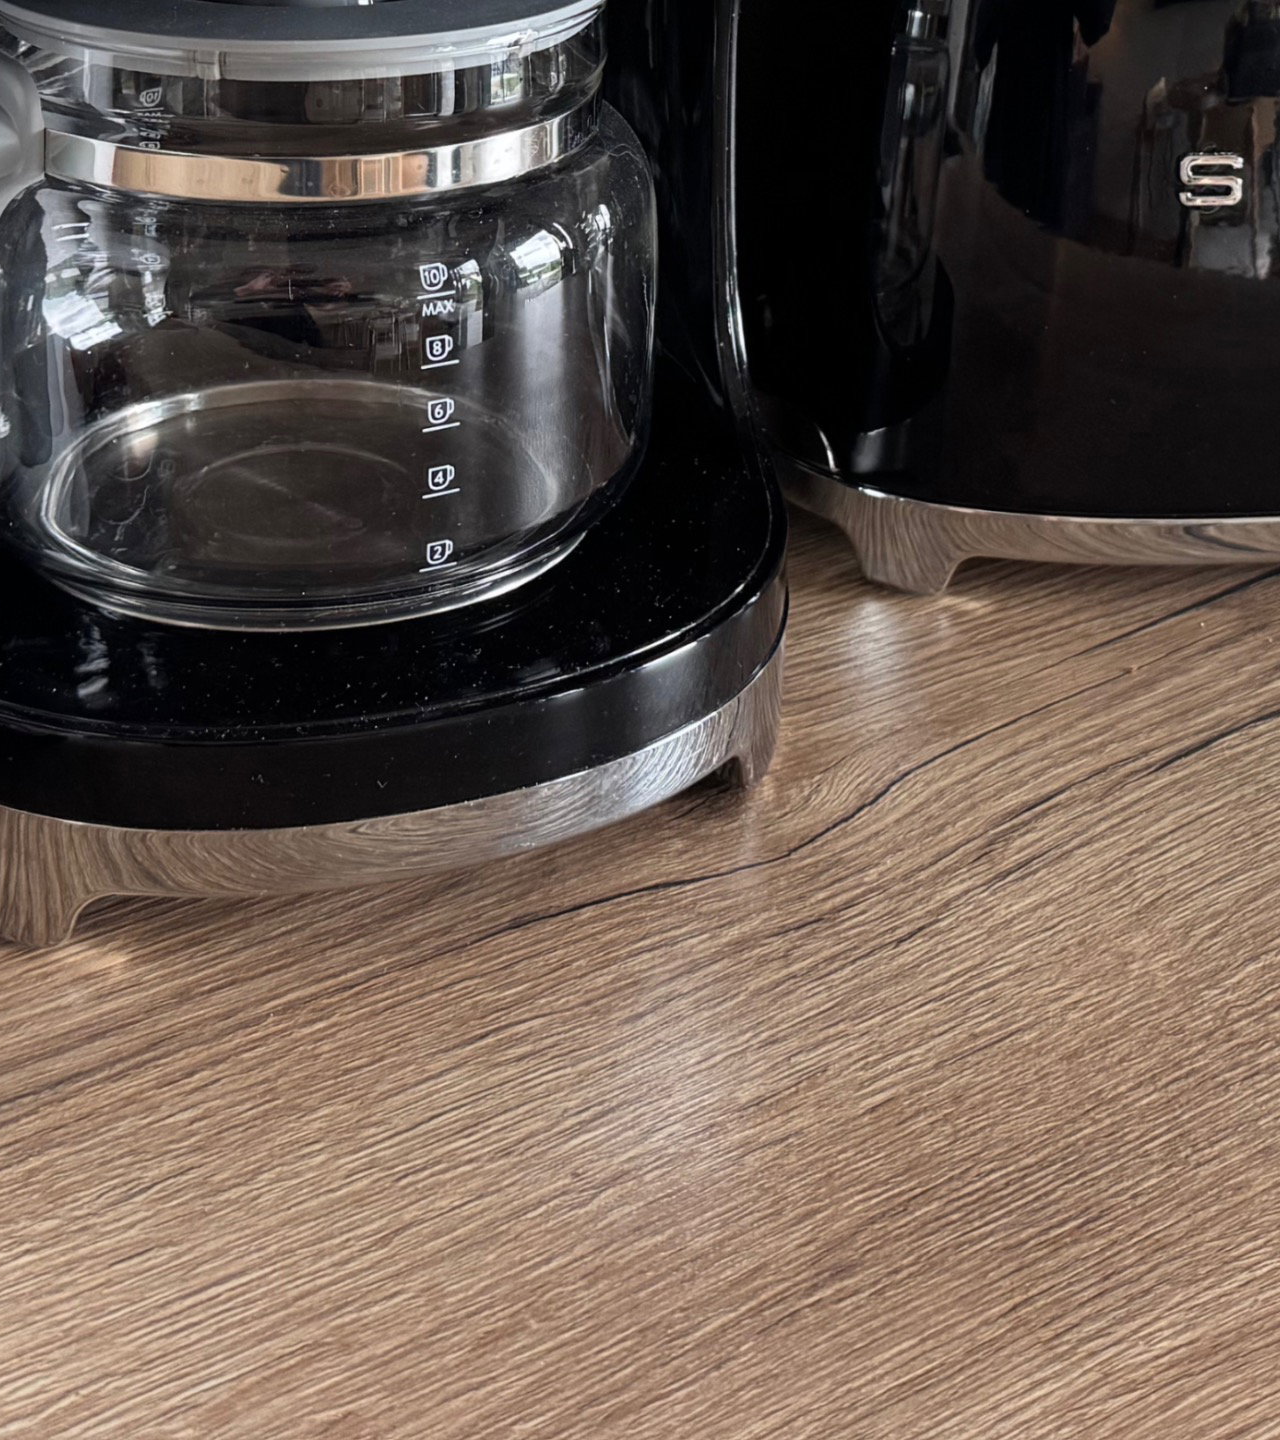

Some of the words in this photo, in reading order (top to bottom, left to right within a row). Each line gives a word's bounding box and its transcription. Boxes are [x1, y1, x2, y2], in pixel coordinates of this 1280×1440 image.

[423, 269, 440, 285] 10
[422, 299, 455, 317] MAX
[432, 341, 442, 355] 8
[434, 404, 443, 418] 6
[434, 471, 444, 484] 4
[433, 546, 442, 560] 2
